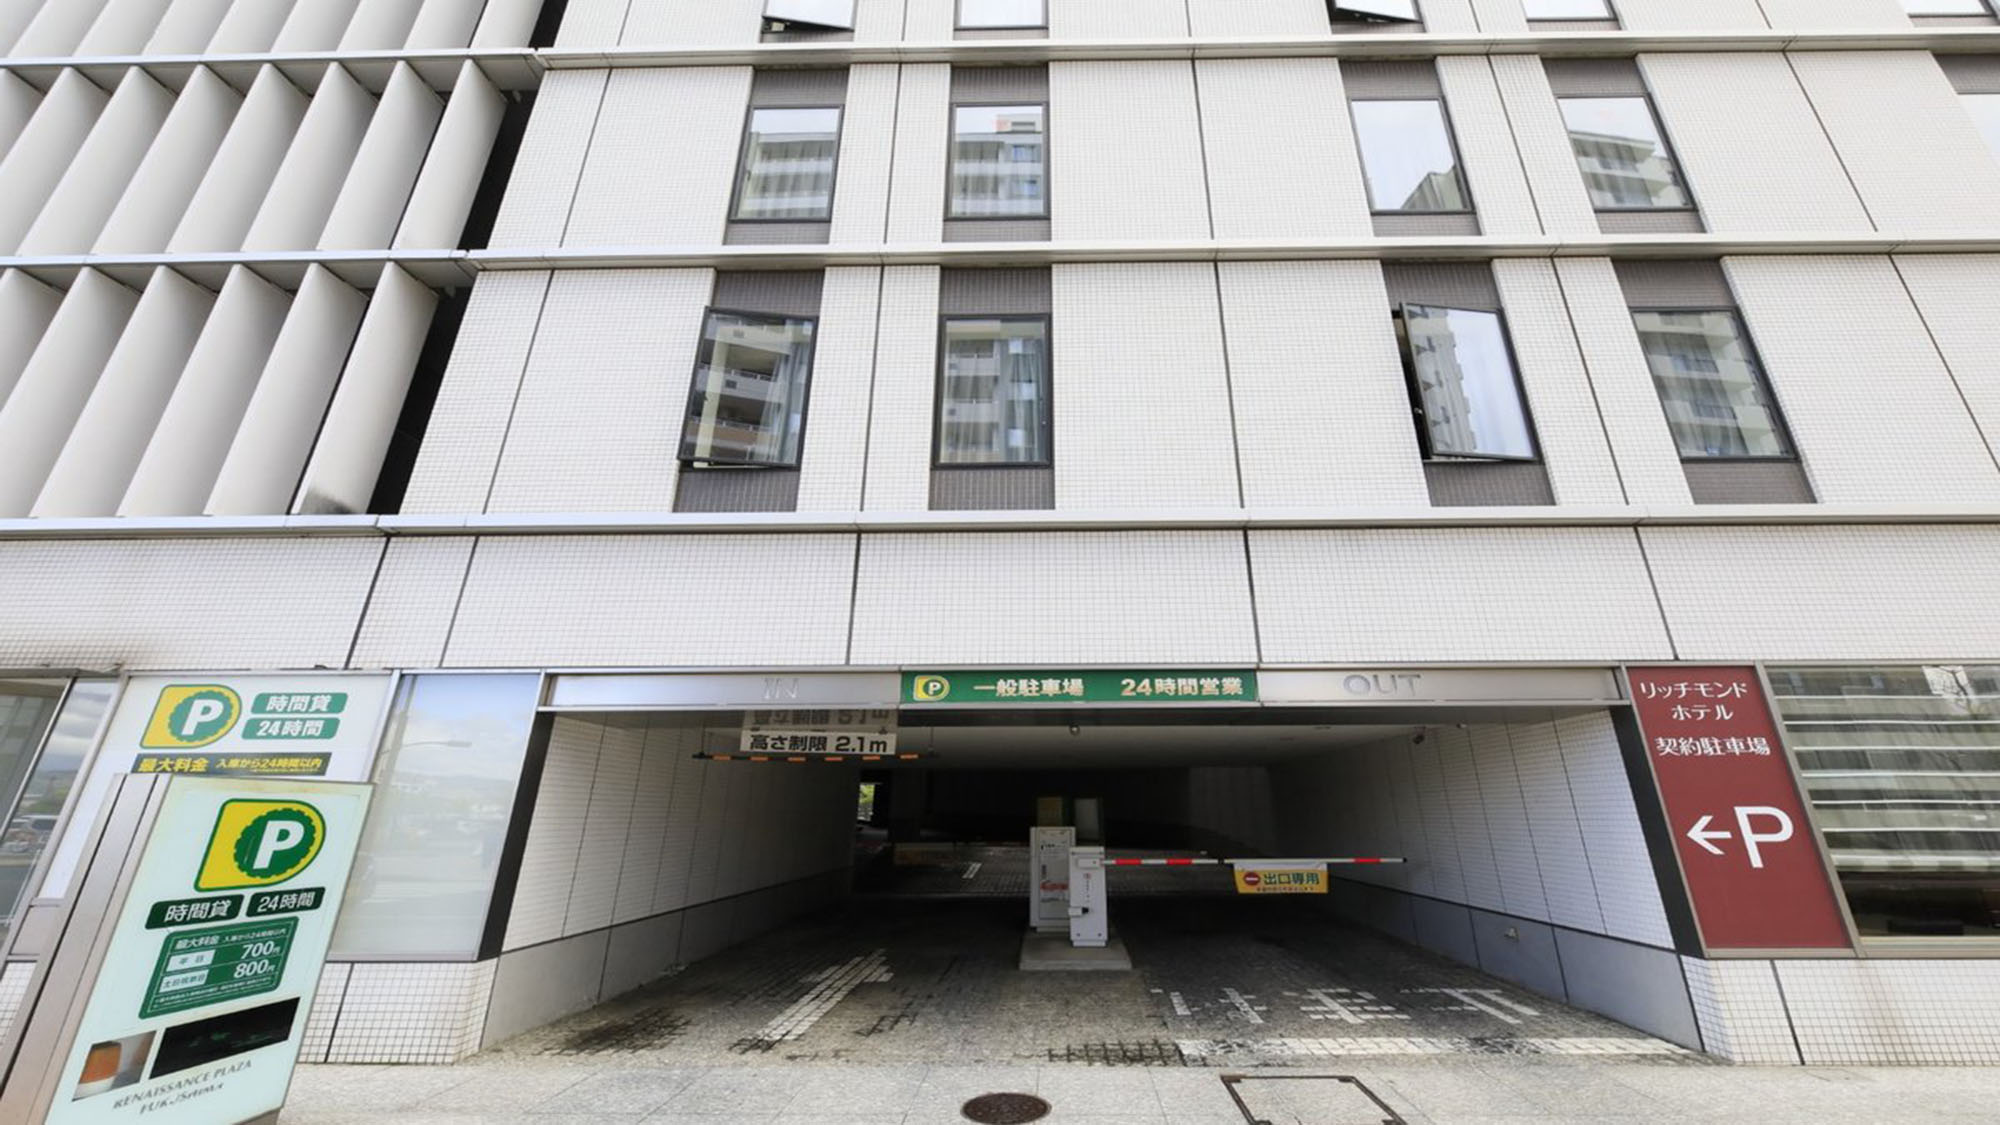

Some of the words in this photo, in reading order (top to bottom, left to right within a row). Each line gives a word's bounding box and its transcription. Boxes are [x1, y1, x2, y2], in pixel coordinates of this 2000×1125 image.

[763, 677, 798, 699] IN
[973, 678, 1085, 697] 一般駐車場
[1121, 677, 1244, 696] 24時間営業
[1343, 674, 1421, 696] OUT
[1640, 682, 1747, 699] リッチモンド
[266, 695, 332, 712] 時間貸
[1671, 704, 1733, 721] ホテル
[181, 699, 224, 735] P
[256, 720, 324, 737] 24時間
[750, 735, 827, 751] 高さ制限
[835, 736, 887, 752] 2.1m
[1655, 736, 1771, 756] 契約駐車場
[138, 757, 209, 772] 最大料金
[253, 820, 305, 870] P
[1734, 806, 1794, 868] P
[164, 899, 232, 923] 時間貸
[257, 891, 315, 913] 24時間
[113, 1070, 209, 1110] RENAISSANCE
[213, 1060, 252, 1079] PLAZA
